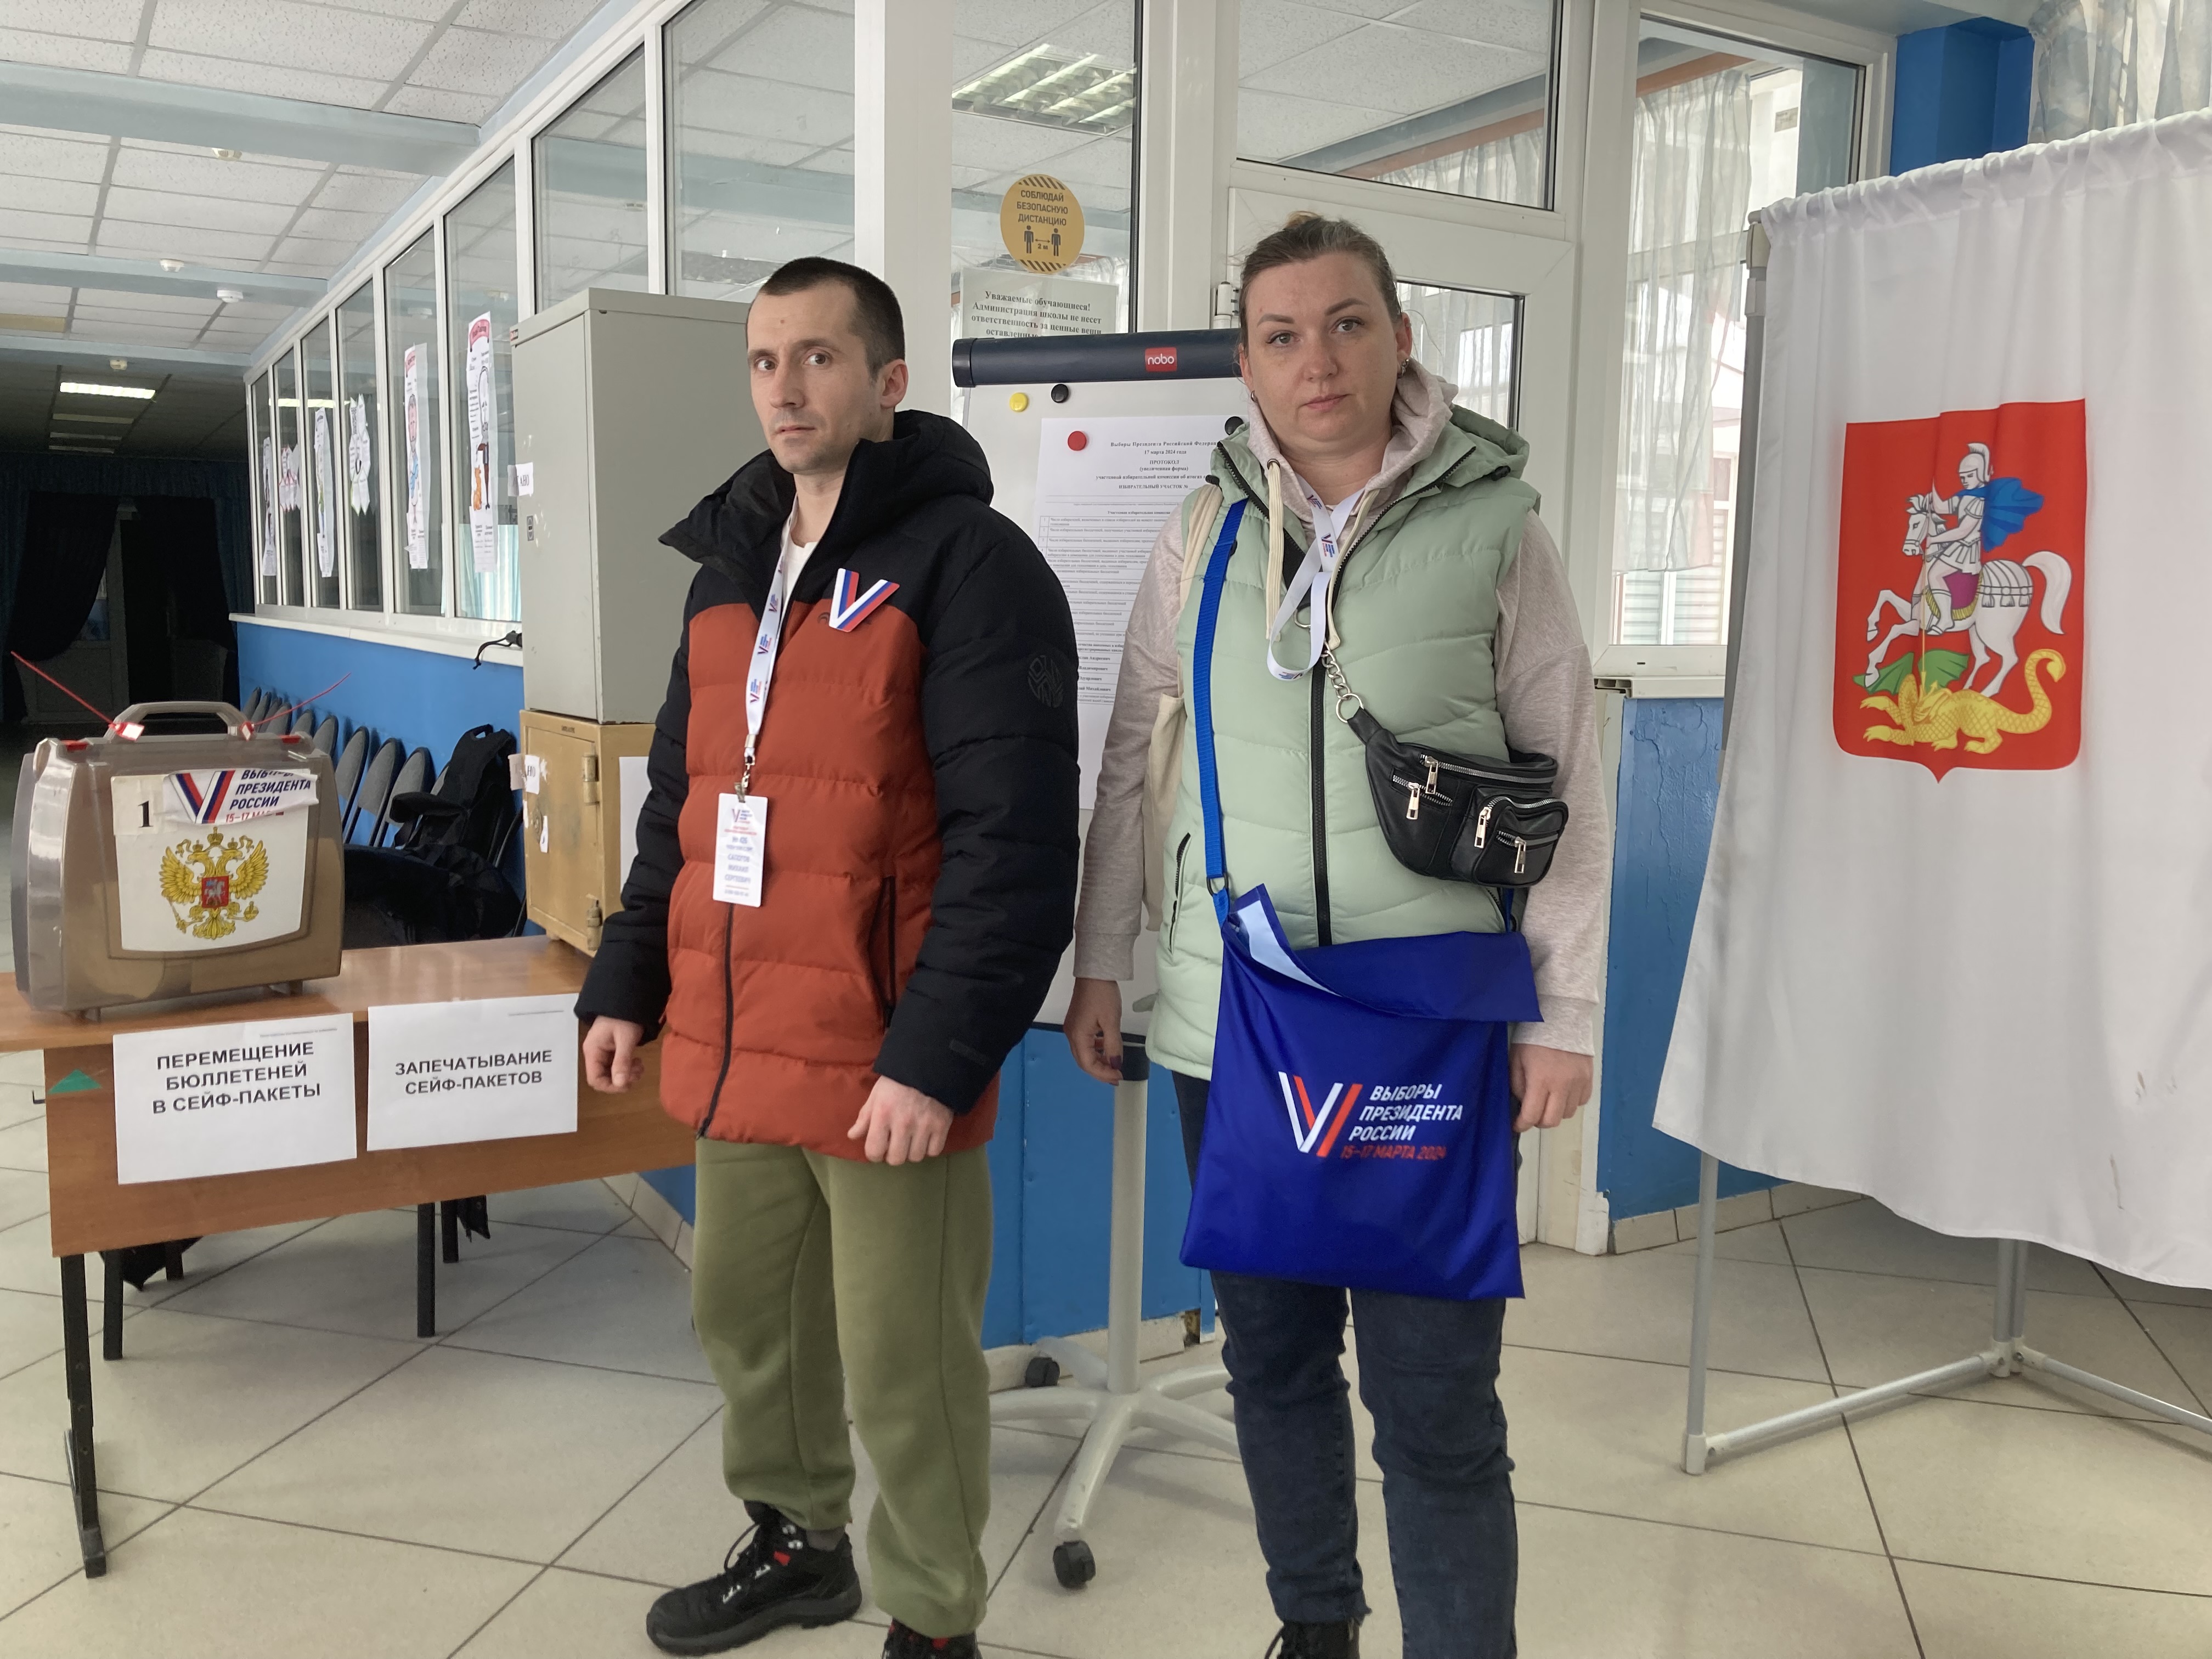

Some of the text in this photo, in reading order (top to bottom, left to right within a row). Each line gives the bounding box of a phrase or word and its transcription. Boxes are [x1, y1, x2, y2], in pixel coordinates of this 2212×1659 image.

[1020, 190, 1064, 202] СОБЛЮДАЙ
[1017, 201, 1068, 215] БЕЗОПАСНУЮ
[1018, 213, 1066, 226] ДИСТАНЦИЮ
[985, 291, 1091, 312] Уважаемые обучающиеся!
[972, 302, 1038, 317] Администрация
[1040, 311, 1069, 320] школы
[1081, 316, 1102, 324] несет
[972, 315, 1039, 329] ответственность
[1050, 323, 1080, 333] ценные
[1147, 353, 1175, 365] nobo
[235, 779, 311, 795] ПРЕЗИДЕНТА
[229, 796, 280, 810] РОССИИ
[138, 800, 154, 828] 1
[156, 1041, 315, 1071] ПЕРЕМЕЩЕНИЕ
[394, 1049, 553, 1076] ЗАПЕЧАТЫВАНИЕ
[166, 1059, 308, 1091] БЮЛЛЕТЕНЕЙ
[405, 1070, 543, 1096] СЕЙФ-ПАКЕТОВ
[151, 1082, 322, 1115] В СЕЙФ-ПАКЕТЫ
[1369, 1084, 1442, 1101] ВЫБОРЫ
[1358, 1104, 1463, 1122] ПРЕЗИДЕНТА
[1348, 1125, 1417, 1142] РОССИИ
